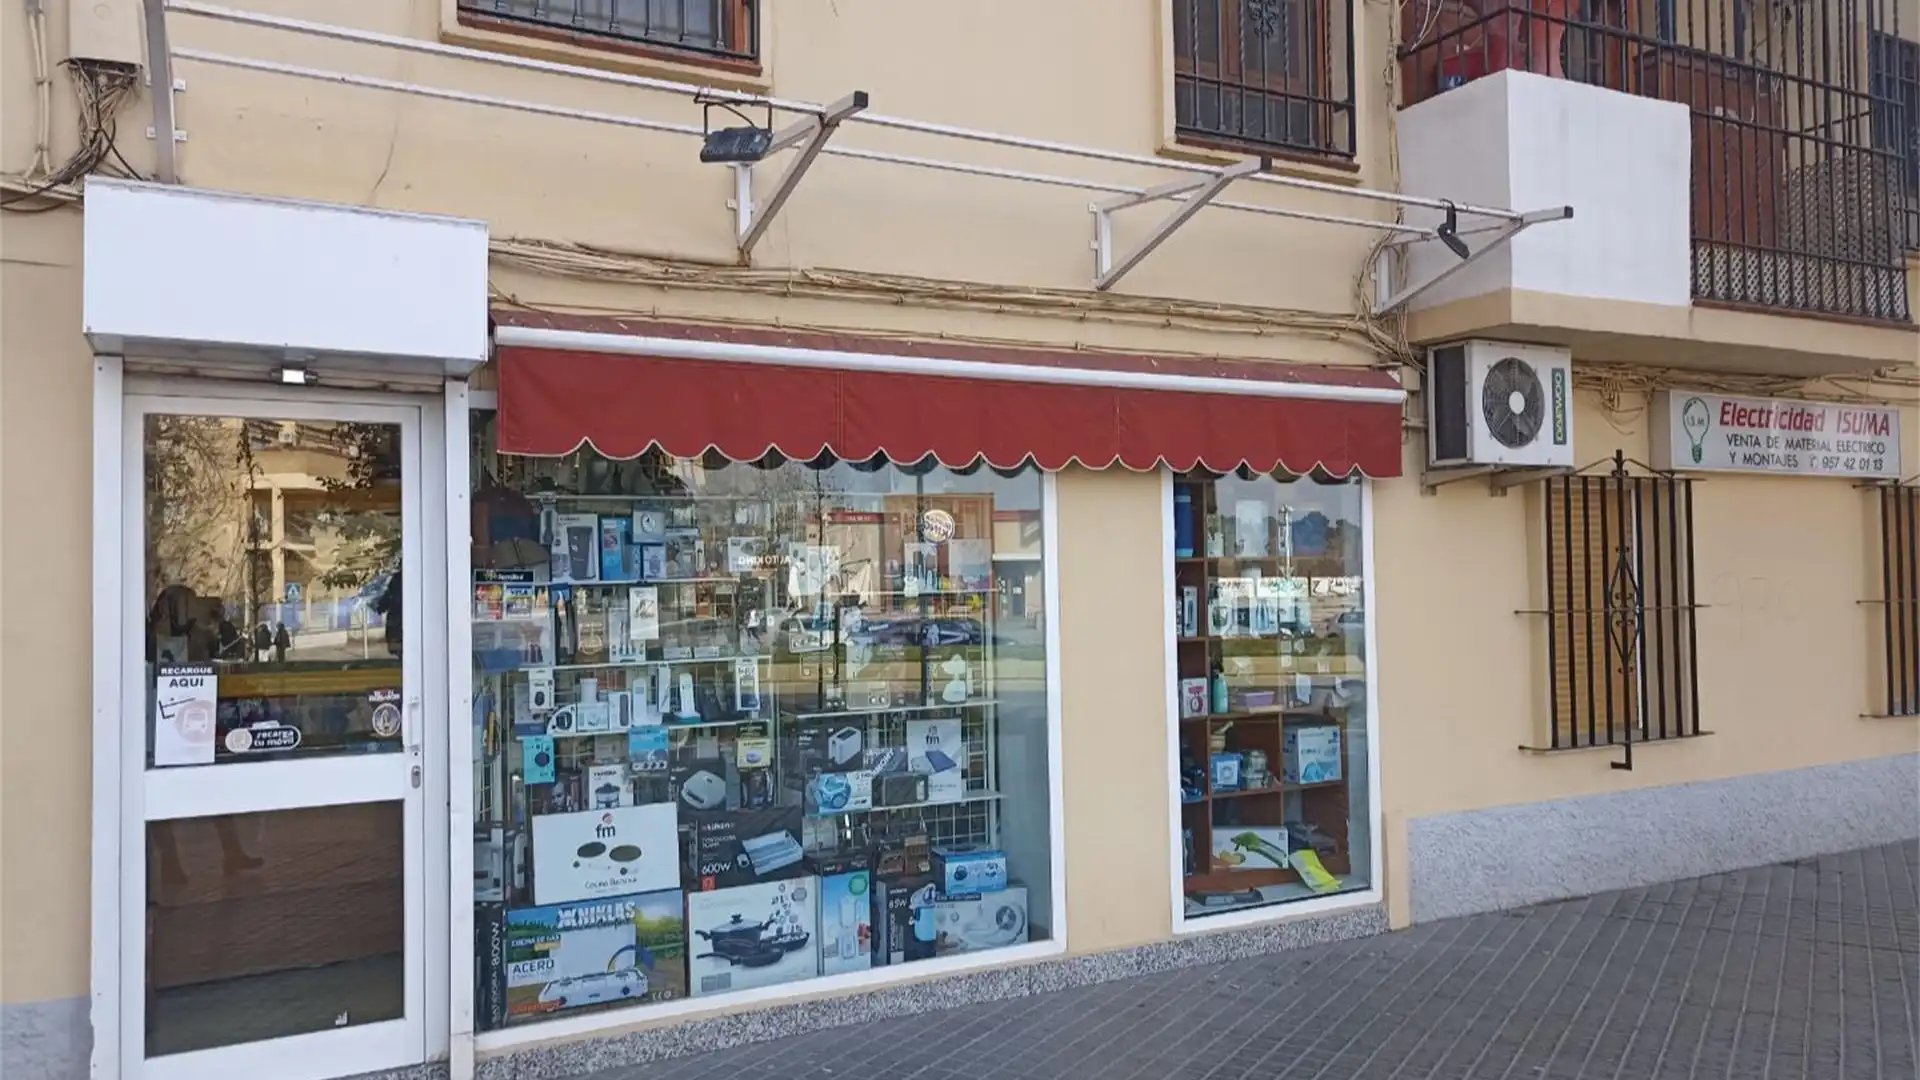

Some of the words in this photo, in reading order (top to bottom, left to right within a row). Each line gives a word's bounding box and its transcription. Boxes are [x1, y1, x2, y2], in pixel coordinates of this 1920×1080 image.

[1720, 401, 1826, 432] Electricidad
[1836, 409, 1890, 437] ISUMA
[1726, 433, 1762, 448] VENTA
[1766, 435, 1780, 449] DE
[1784, 436, 1832, 452] MATERIAL
[1836, 440, 1885, 455] ELECTRICO
[1729, 451, 1737, 464] Y
[1742, 452, 1799, 469] MONTAJES
[1844, 456, 1856, 470] 42
[161, 666, 213, 675] RECARGUE
[257, 730, 294, 740] recarga
[595, 824, 616, 838] fm
[701, 861, 732, 875] 600W
[577, 901, 637, 924] NIKLAS
[491, 921, 501, 966] 800W
[512, 959, 555, 974] ACERO
